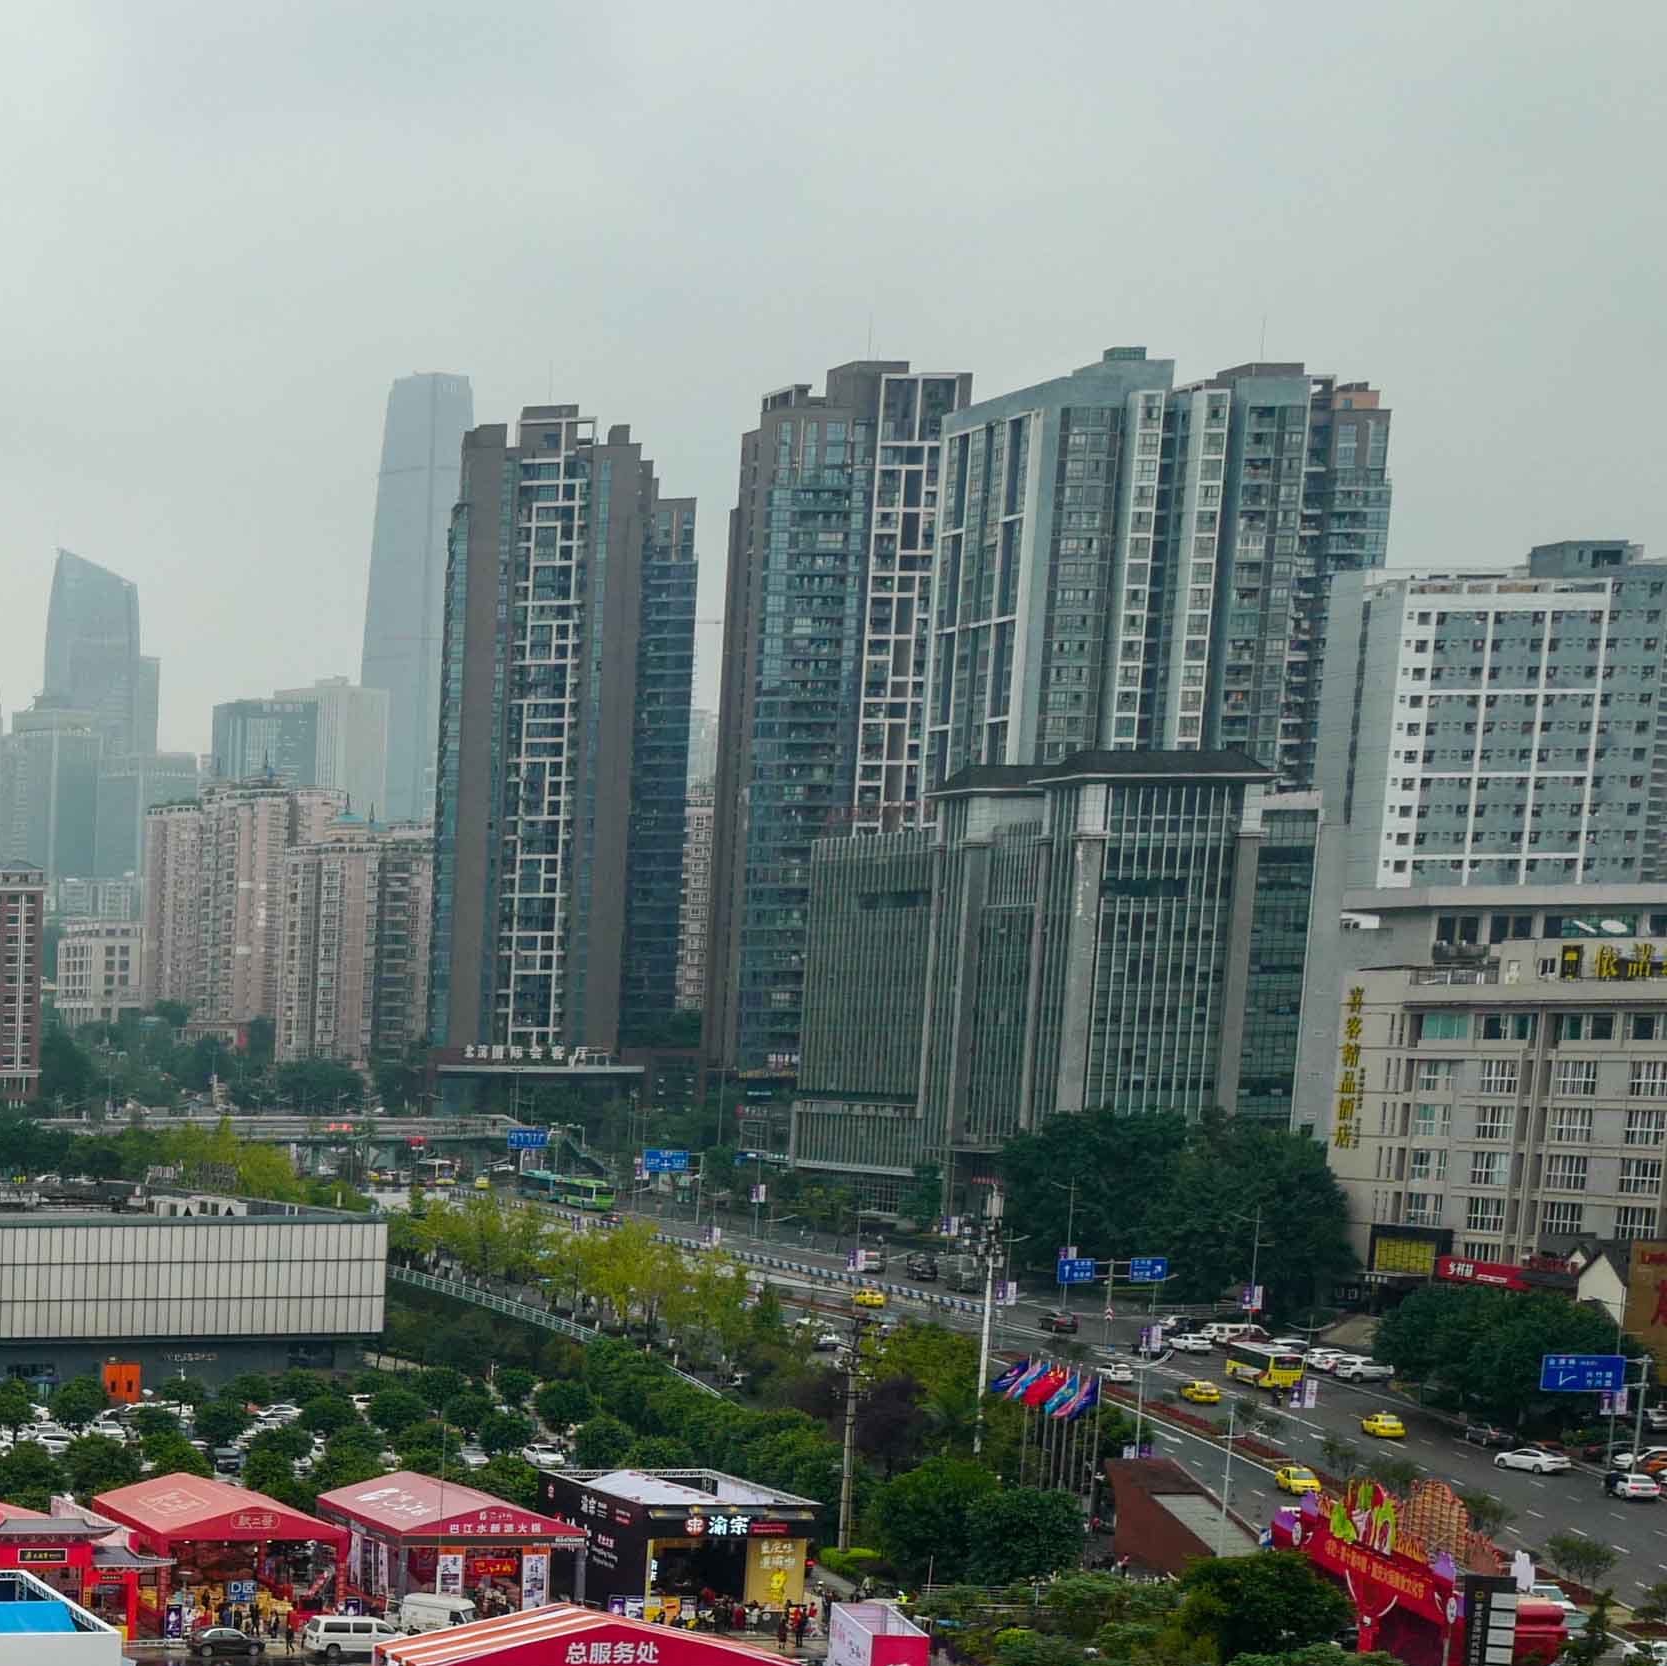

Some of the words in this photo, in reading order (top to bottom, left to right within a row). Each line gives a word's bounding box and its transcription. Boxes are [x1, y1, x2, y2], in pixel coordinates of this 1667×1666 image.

[708, 1515, 749, 1535] 渝宗
[229, 1582, 256, 1593] D区
[565, 1640, 660, 1665] 总服务处
